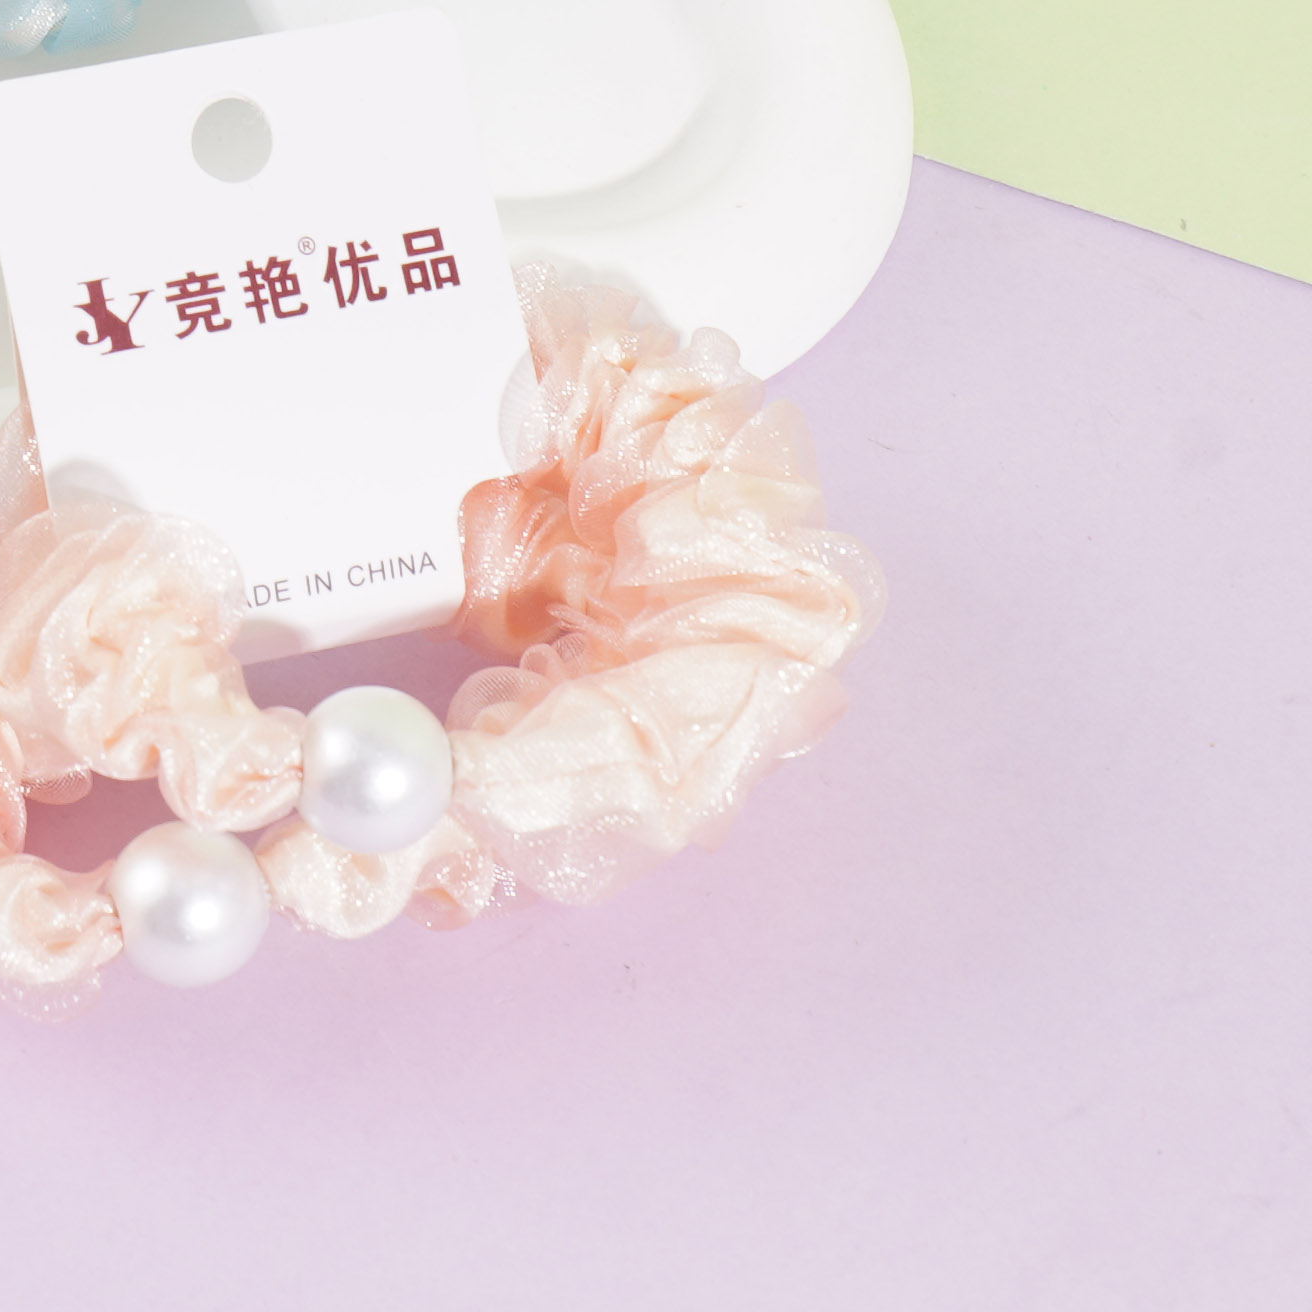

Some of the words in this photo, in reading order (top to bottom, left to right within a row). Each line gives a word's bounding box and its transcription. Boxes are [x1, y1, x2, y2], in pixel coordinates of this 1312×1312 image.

[165, 227, 461, 339] 竞艳优品
[246, 579, 292, 608] DE
[305, 570, 333, 597] IN
[347, 551, 437, 588] CHINA
